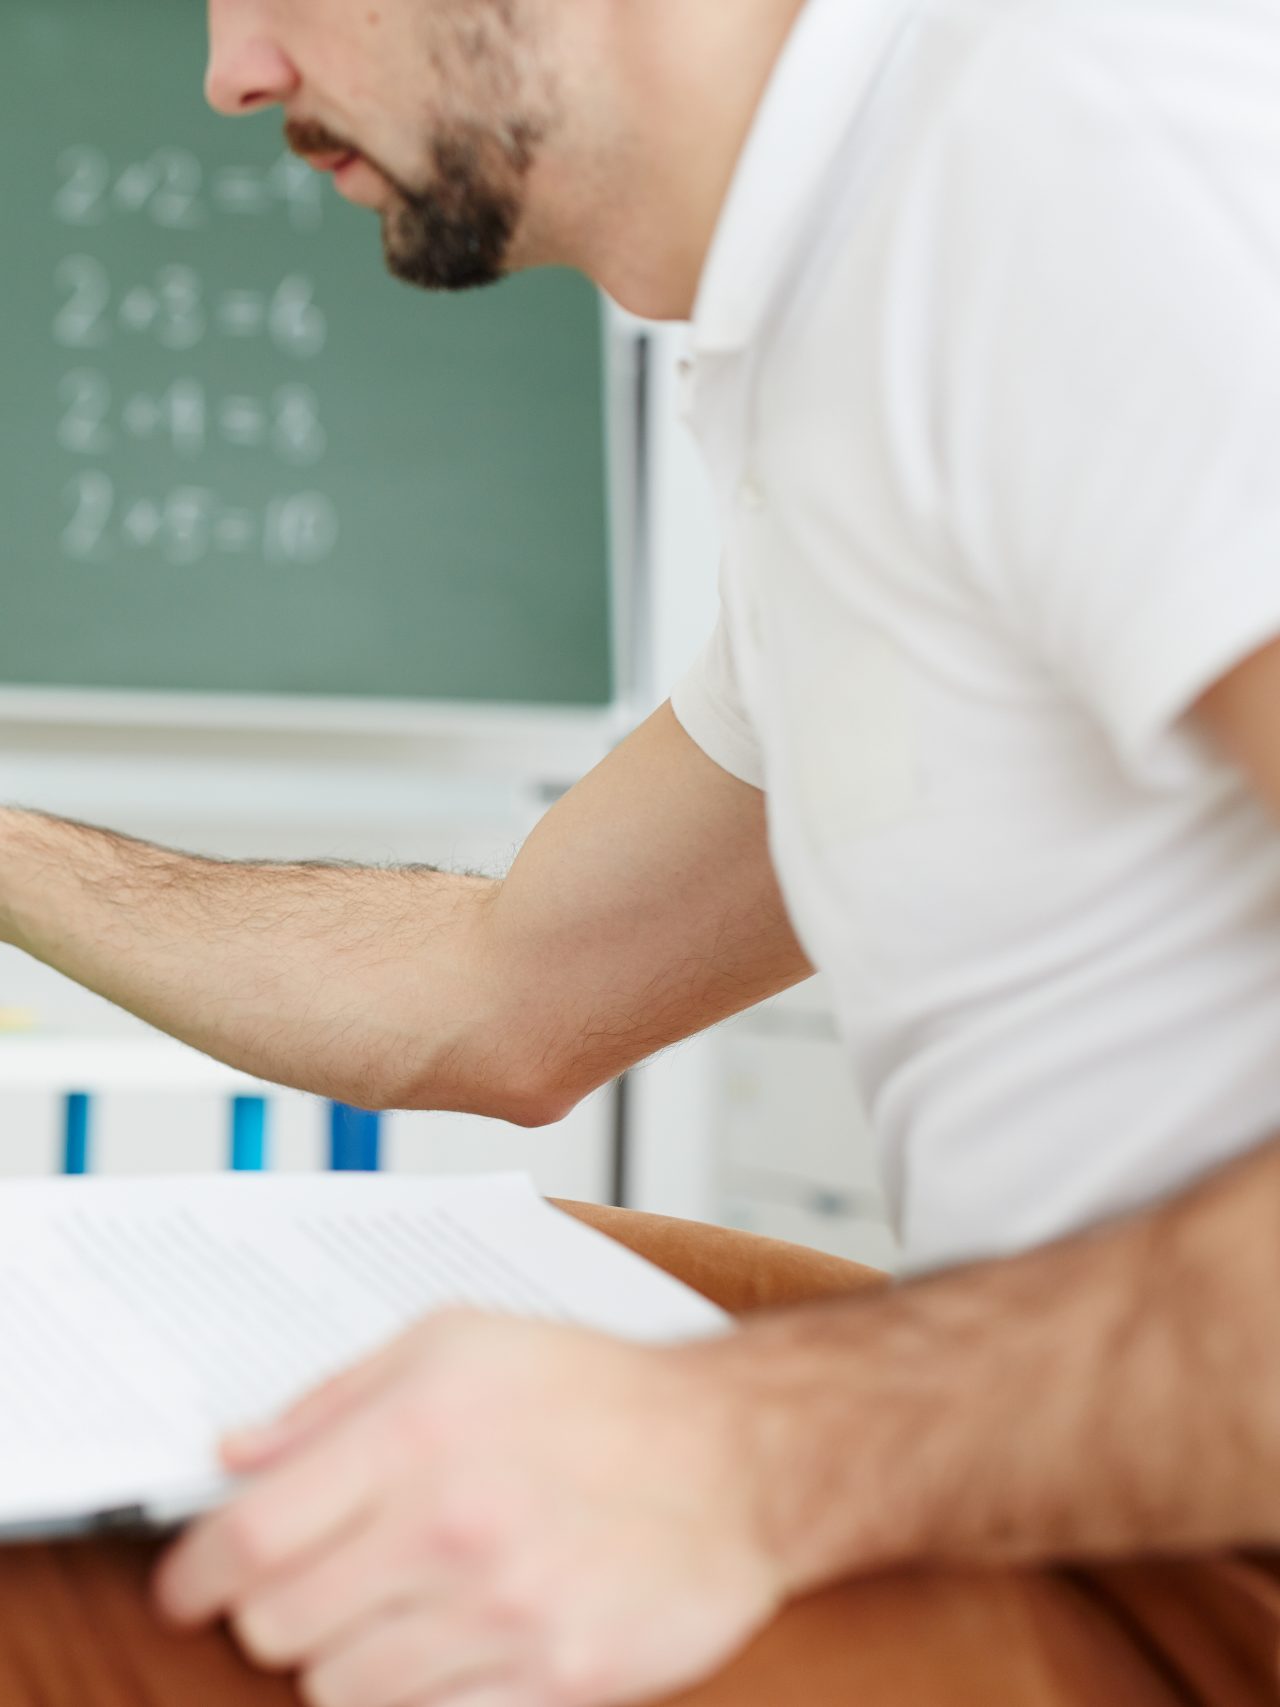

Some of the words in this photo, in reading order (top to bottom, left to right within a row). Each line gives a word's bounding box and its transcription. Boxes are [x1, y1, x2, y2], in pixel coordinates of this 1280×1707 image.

[52, 252, 112, 349] 2
[269, 273, 328, 359] 6
[56, 367, 114, 455] 2
